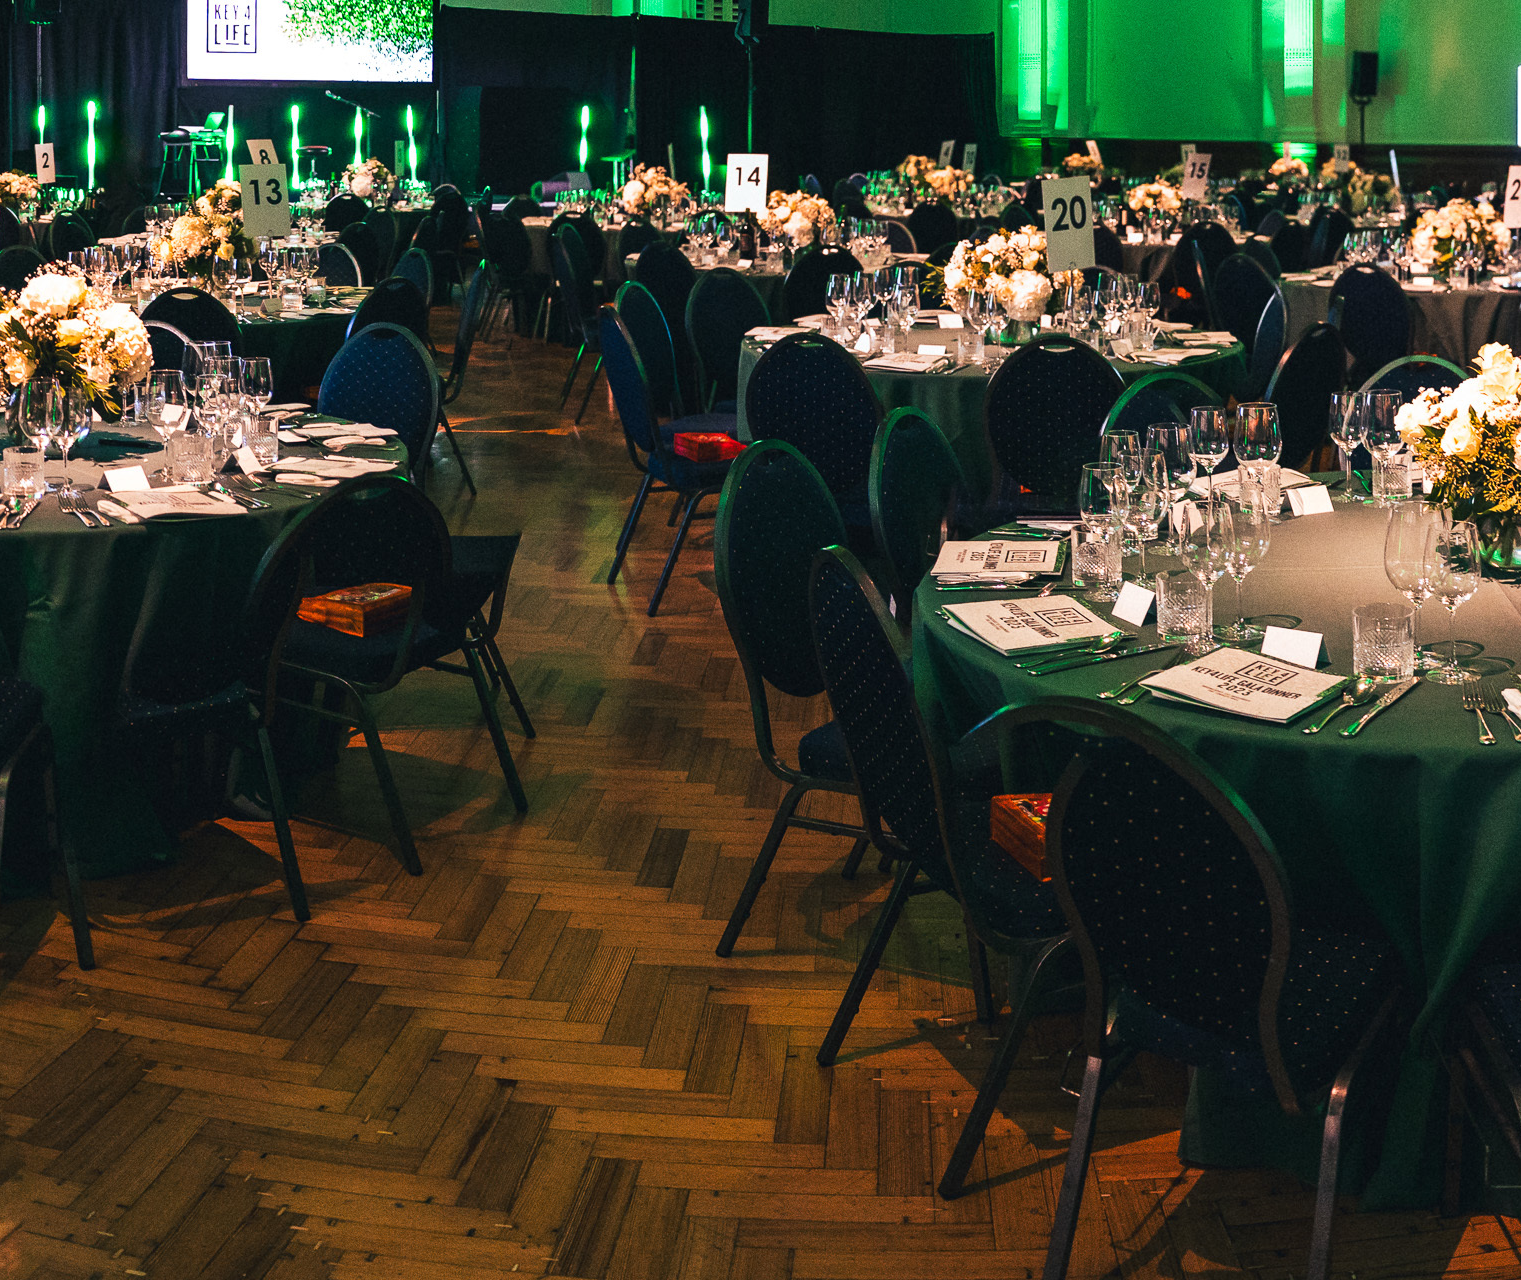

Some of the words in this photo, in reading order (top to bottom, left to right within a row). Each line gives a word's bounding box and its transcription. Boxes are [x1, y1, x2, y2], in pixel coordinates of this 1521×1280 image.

[214, 4, 239, 20] KEY
[214, 24, 251, 46] LIFE
[41, 152, 50, 169] 2
[735, 166, 761, 187] 14
[1190, 162, 1206, 179] 15
[249, 178, 283, 206] 13
[1051, 195, 1087, 232] 20
[1244, 668, 1282, 683] LIFE
[1254, 664, 1280, 675] KEY
[1191, 665, 1239, 684] KEY4LIFE
[1236, 679, 1263, 692] GALA
[1261, 686, 1302, 699] DINNER
[1217, 682, 1254, 696] 2023
